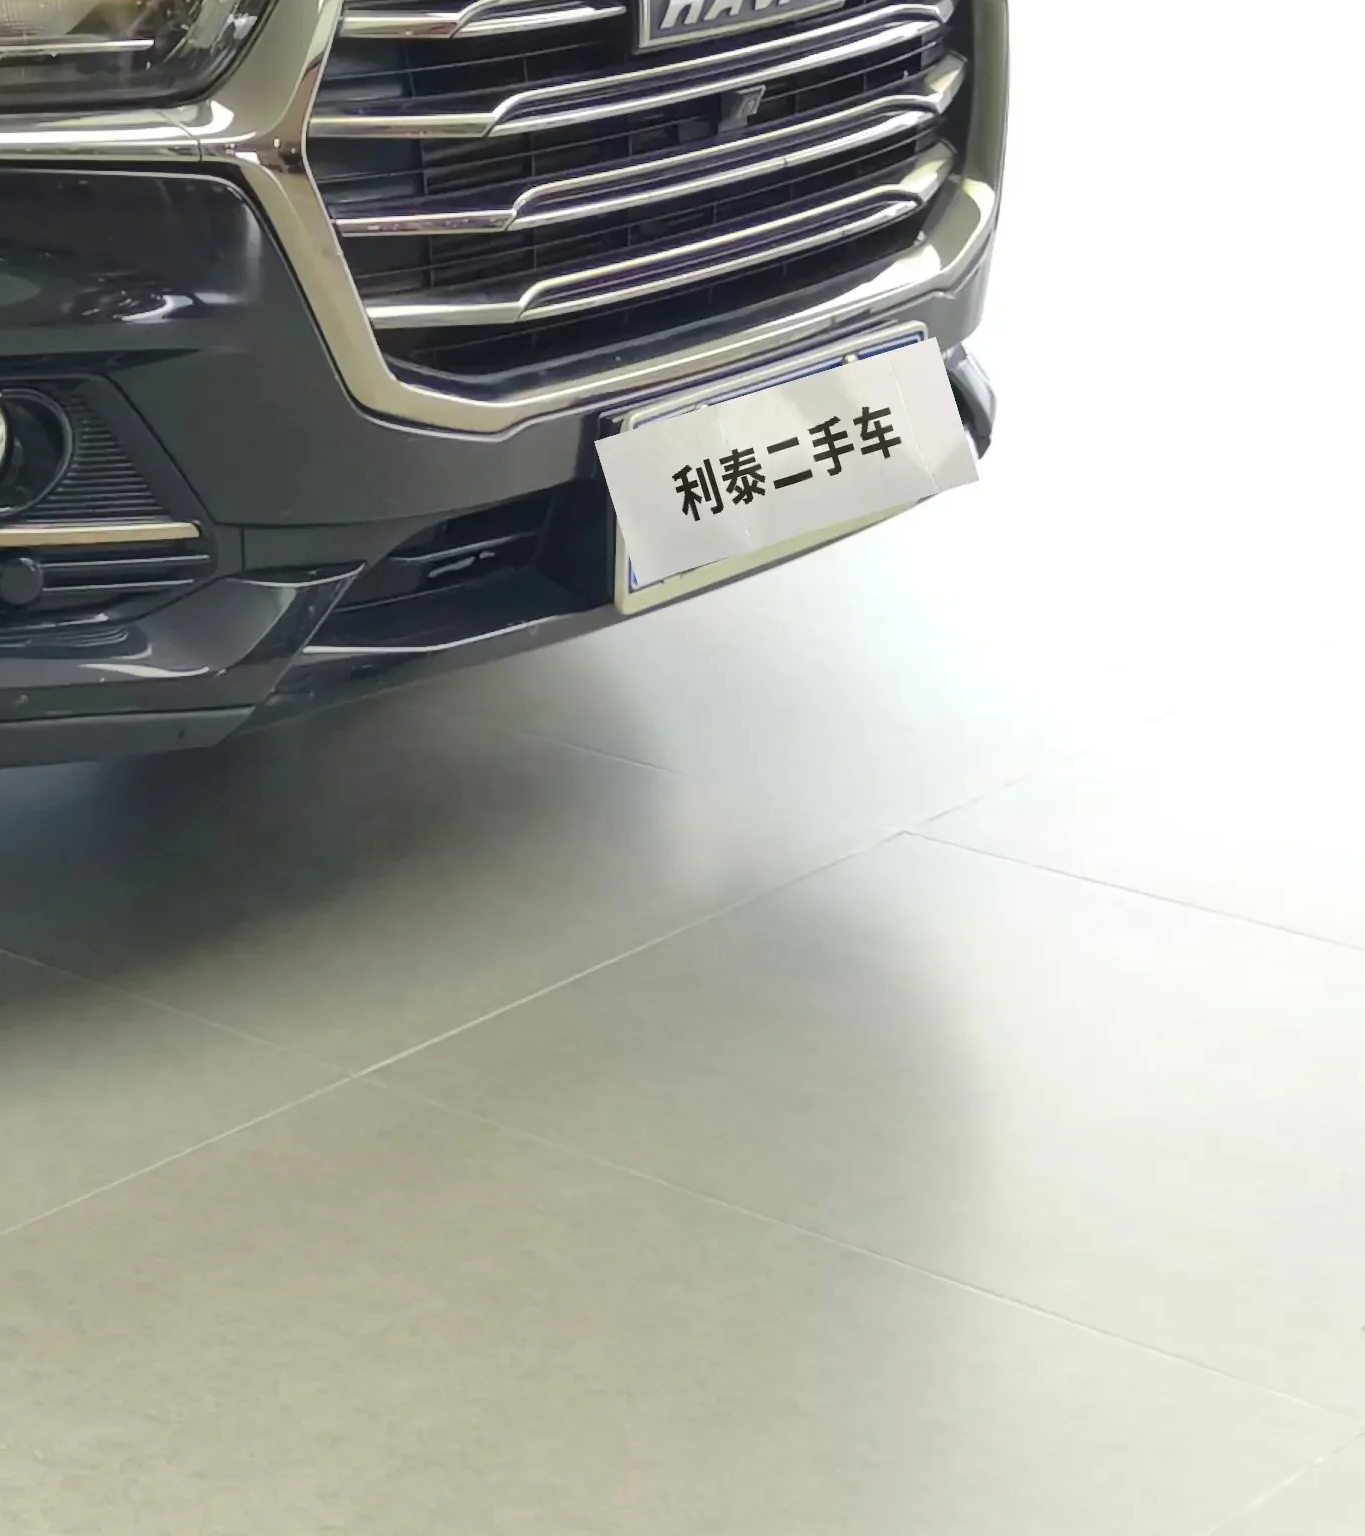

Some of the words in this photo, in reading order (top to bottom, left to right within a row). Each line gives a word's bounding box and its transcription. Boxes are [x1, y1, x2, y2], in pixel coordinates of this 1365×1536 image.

[672, 406, 902, 522] 利泰二手车
